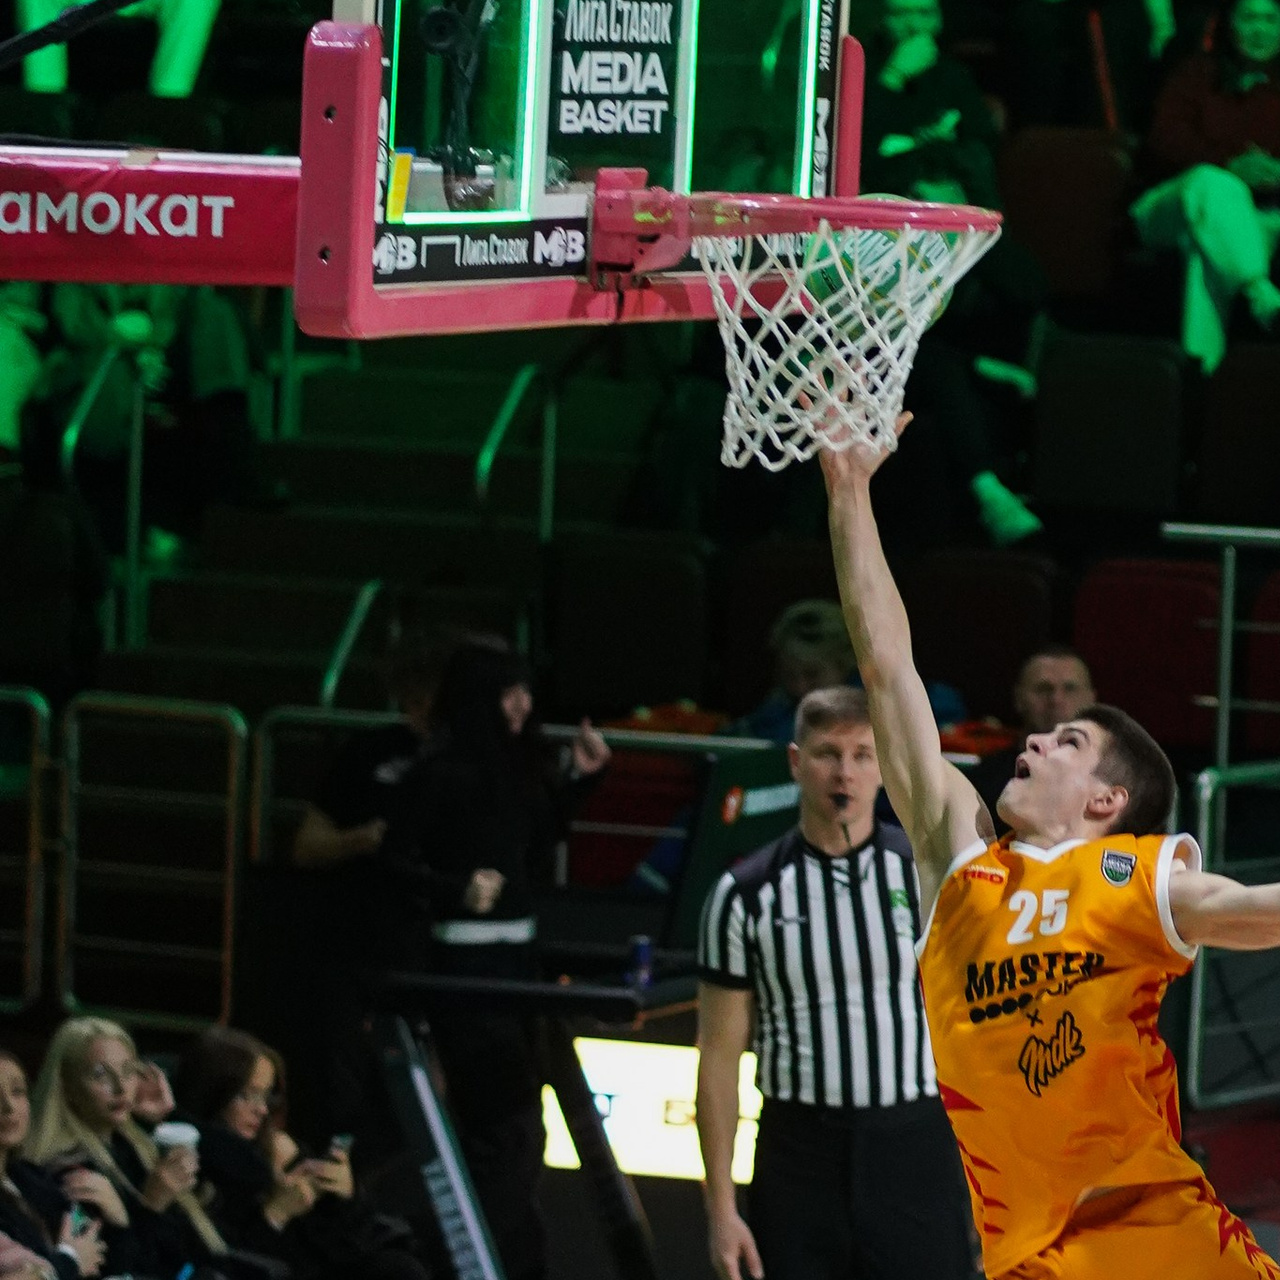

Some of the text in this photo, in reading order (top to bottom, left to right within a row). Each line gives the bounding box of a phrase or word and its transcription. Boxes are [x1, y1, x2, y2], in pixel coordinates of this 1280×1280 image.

[561, 50, 669, 95] MEDIA
[559, 98, 669, 135] BASKET
[1006, 889, 1070, 945] 25
[965, 950, 1105, 1003] MASTER
